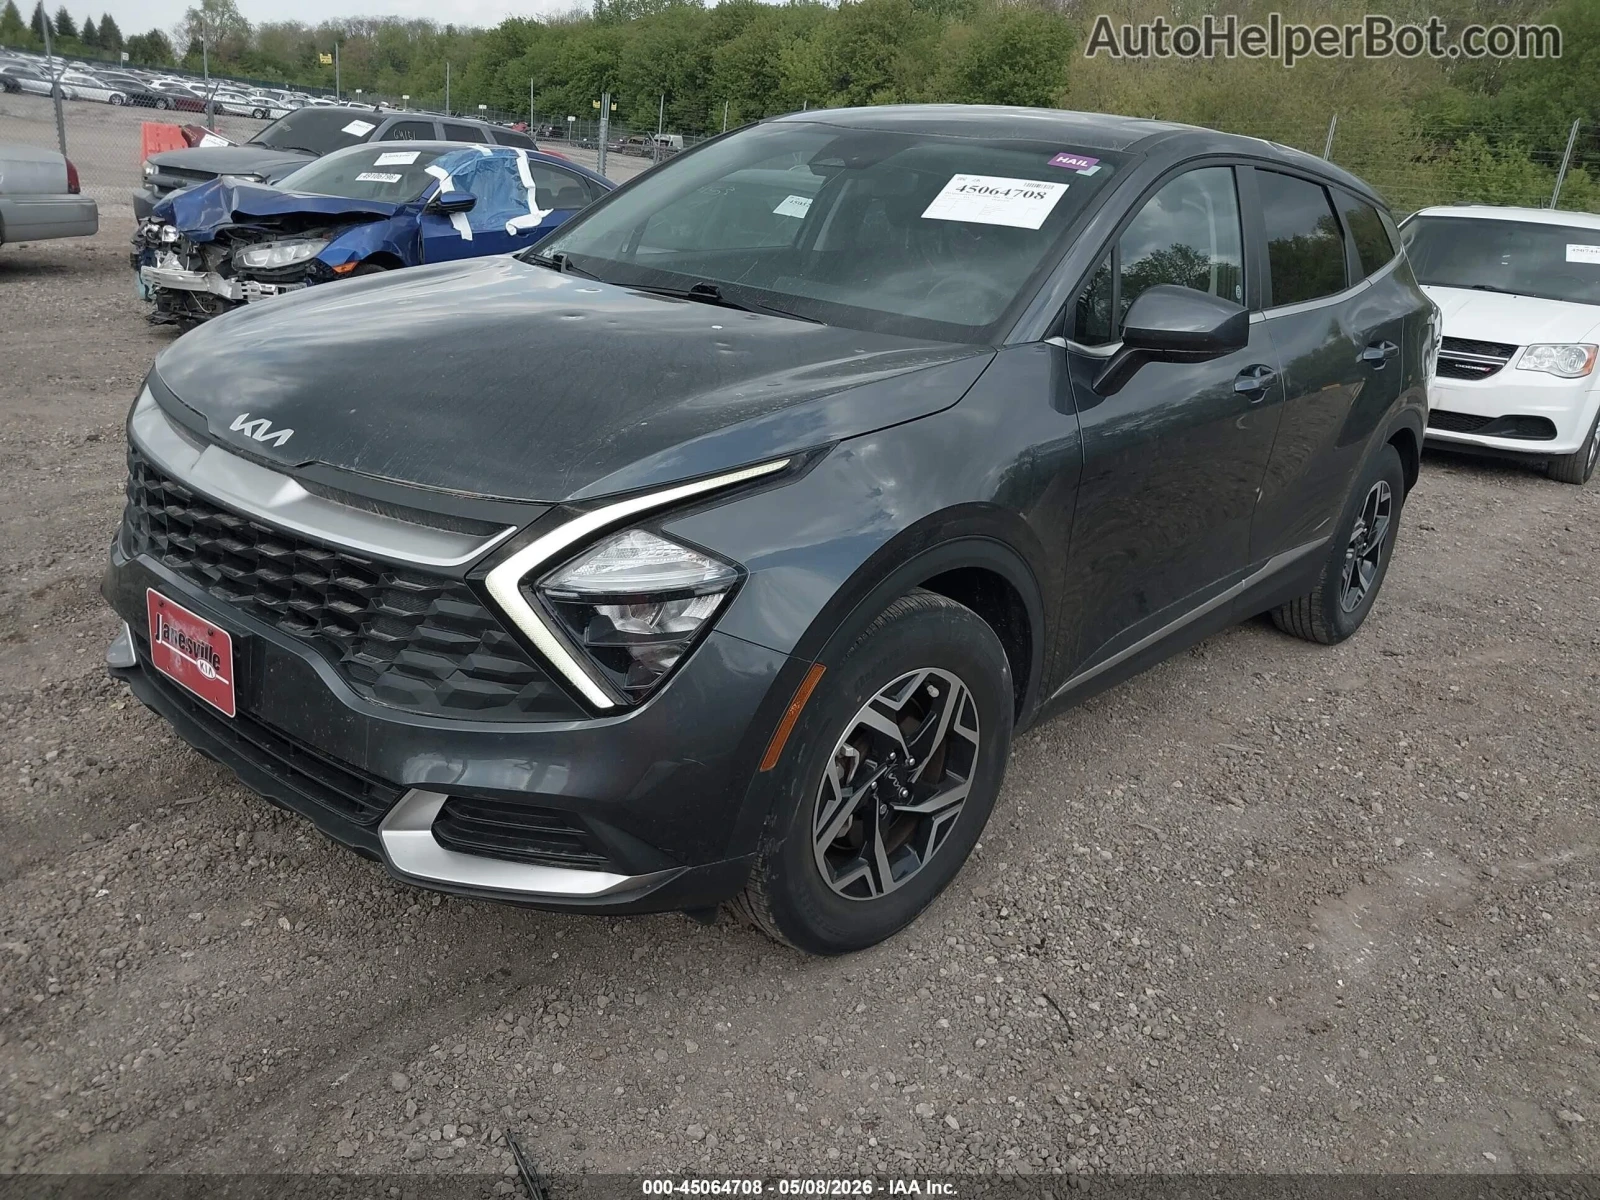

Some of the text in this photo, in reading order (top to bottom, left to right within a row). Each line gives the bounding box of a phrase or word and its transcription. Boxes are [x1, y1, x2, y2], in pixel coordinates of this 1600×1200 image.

[1056, 156, 1088, 167] HAIL
[956, 184, 1047, 200] 45064708
[229, 412, 295, 447] KIA
[154, 612, 222, 671] Janesville
